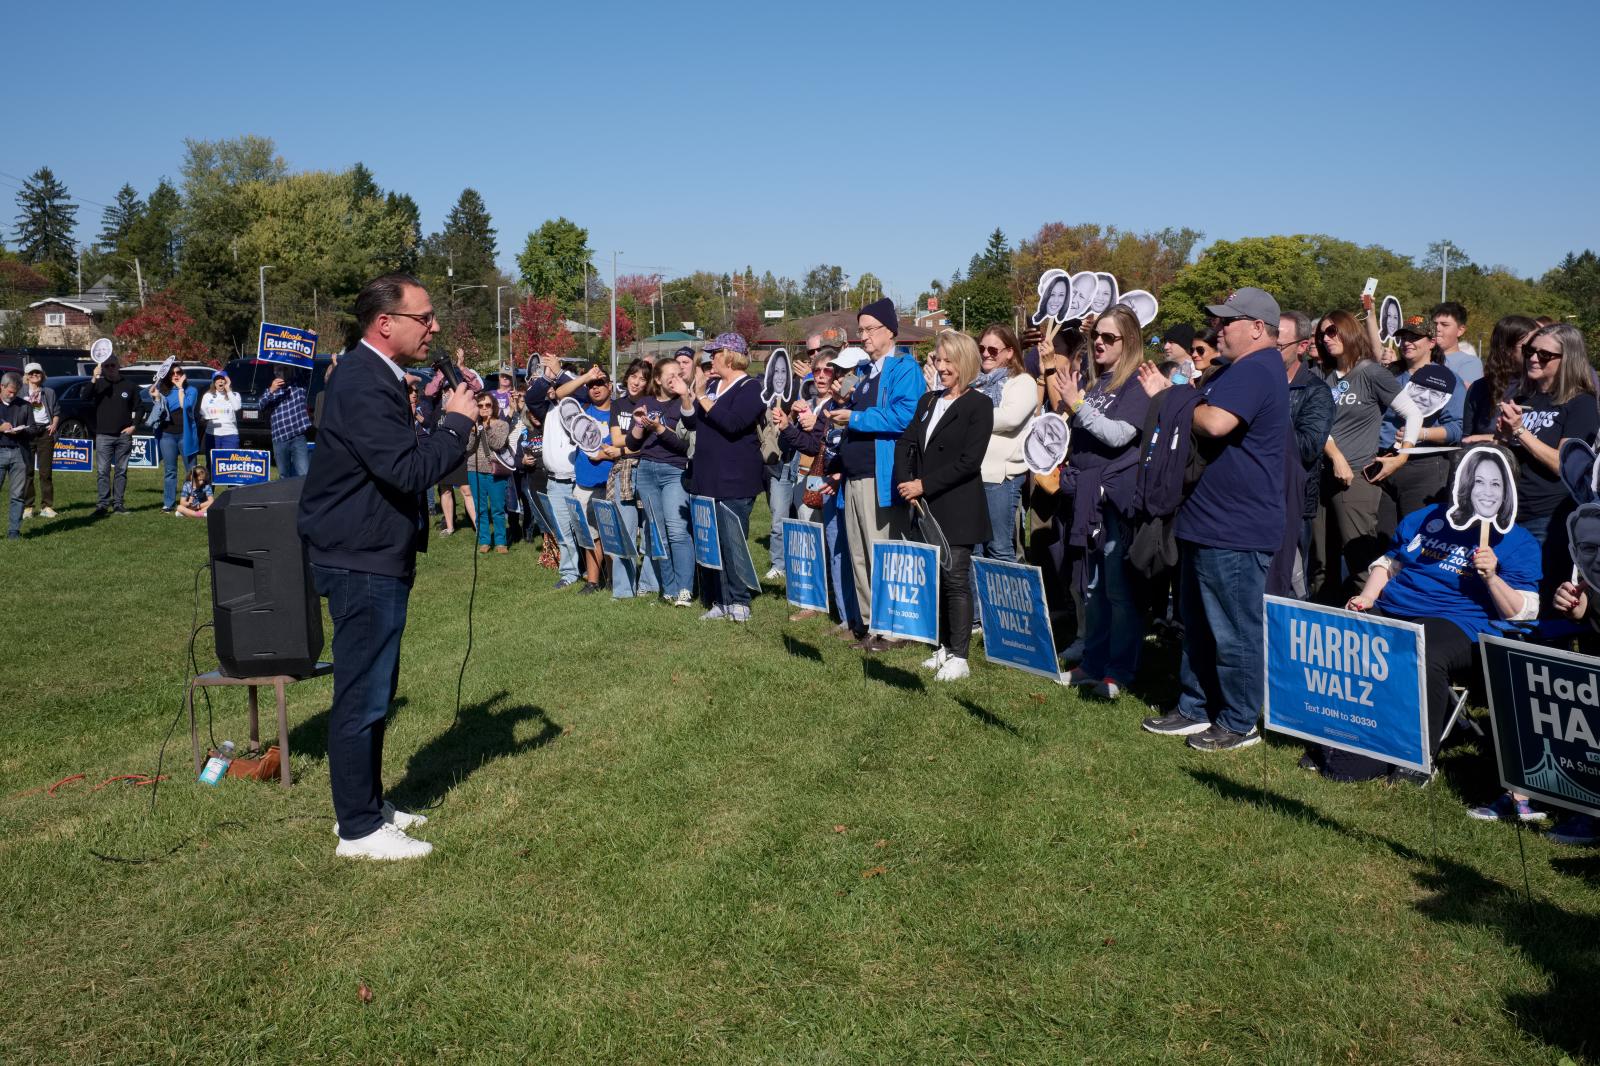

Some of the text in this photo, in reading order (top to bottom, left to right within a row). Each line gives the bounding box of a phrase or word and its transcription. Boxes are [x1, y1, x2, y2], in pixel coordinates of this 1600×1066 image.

[266, 338, 312, 355] Ruscitto
[280, 331, 303, 341] Nicole
[1335, 392, 1362, 405] te.
[218, 461, 263, 473] Ruscitto
[229, 453, 252, 461] Nicole
[788, 530, 817, 560] HARRIS
[791, 558, 813, 577] WALZ
[882, 552, 926, 587] HARRIS
[985, 571, 1034, 615] HARRIS
[997, 608, 1033, 636] WALZ
[1289, 618, 1390, 682] HARRIS
[1303, 666, 1375, 707] WALZ
[1303, 701, 1378, 728] Text JOIN to 30330
[1529, 696, 1600, 750] HA
[1560, 756, 1600, 777] PA Stat
